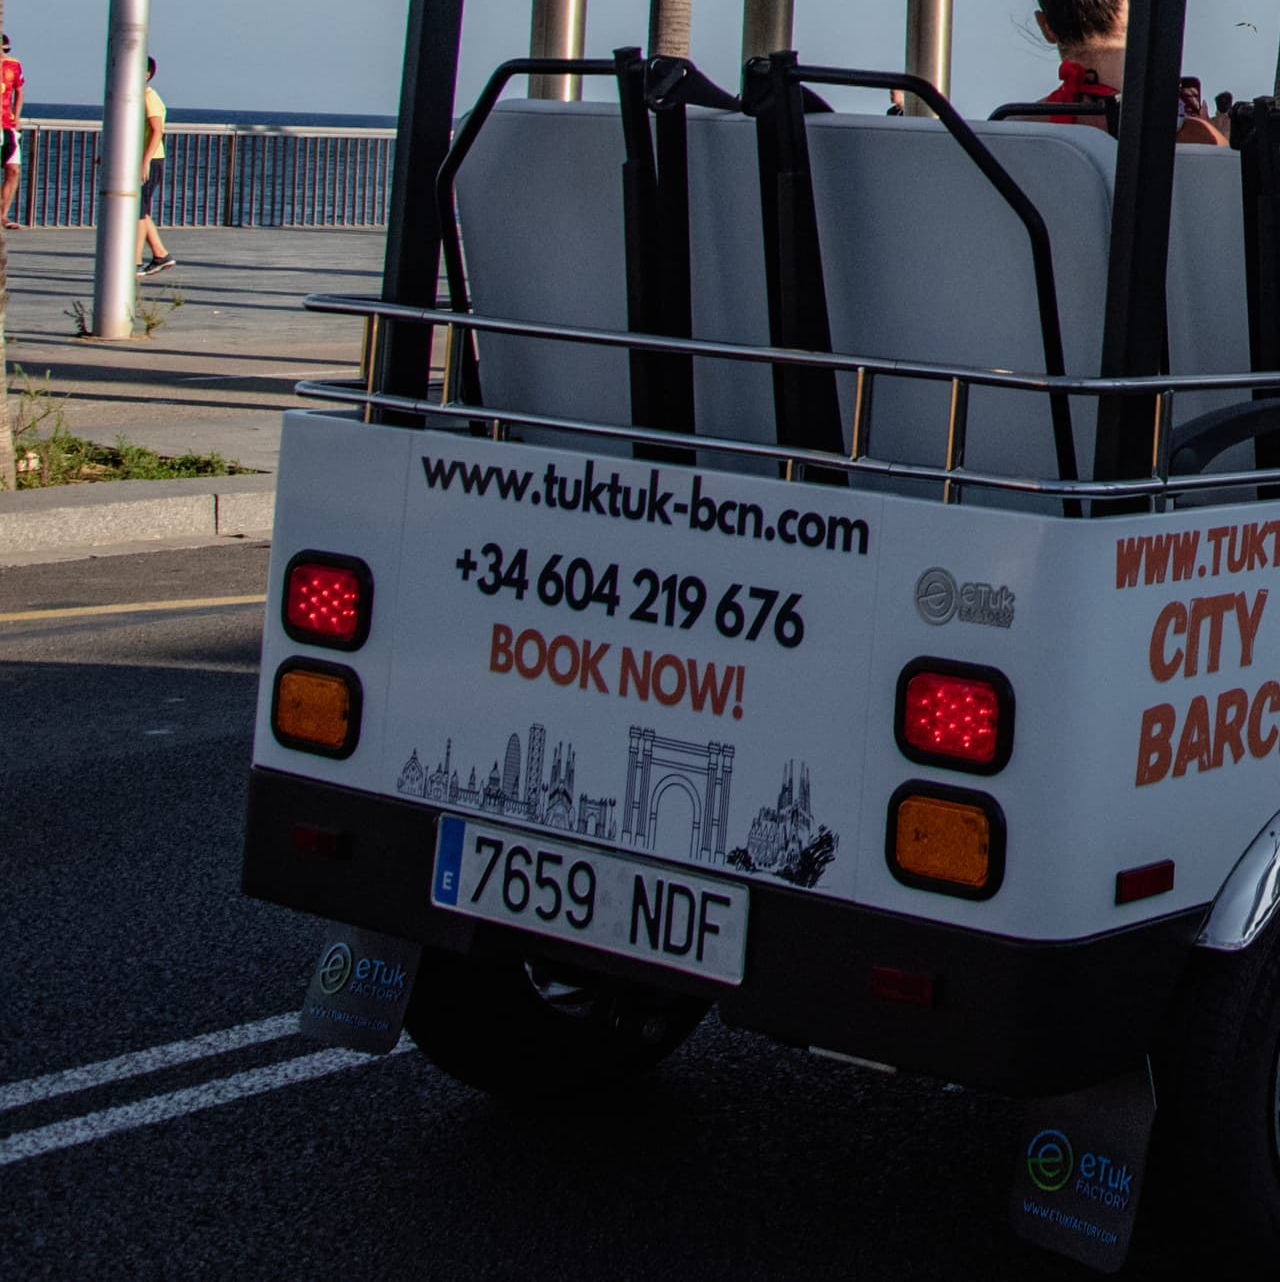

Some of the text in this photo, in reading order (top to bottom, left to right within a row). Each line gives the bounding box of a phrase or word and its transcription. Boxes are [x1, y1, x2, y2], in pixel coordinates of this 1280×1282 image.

[421, 456, 869, 557] www.tuktuk-bcn.com
[456, 543, 805, 649] +34 604 219 676
[1149, 588, 1268, 683] CITY
[489, 623, 746, 720] BOOK NOW!
[442, 835, 732, 962] E 7659 NDF
[354, 957, 408, 989] eTuk
[1075, 1179, 1129, 1210] FACTORY
[1080, 1152, 1133, 1196] eTuk
